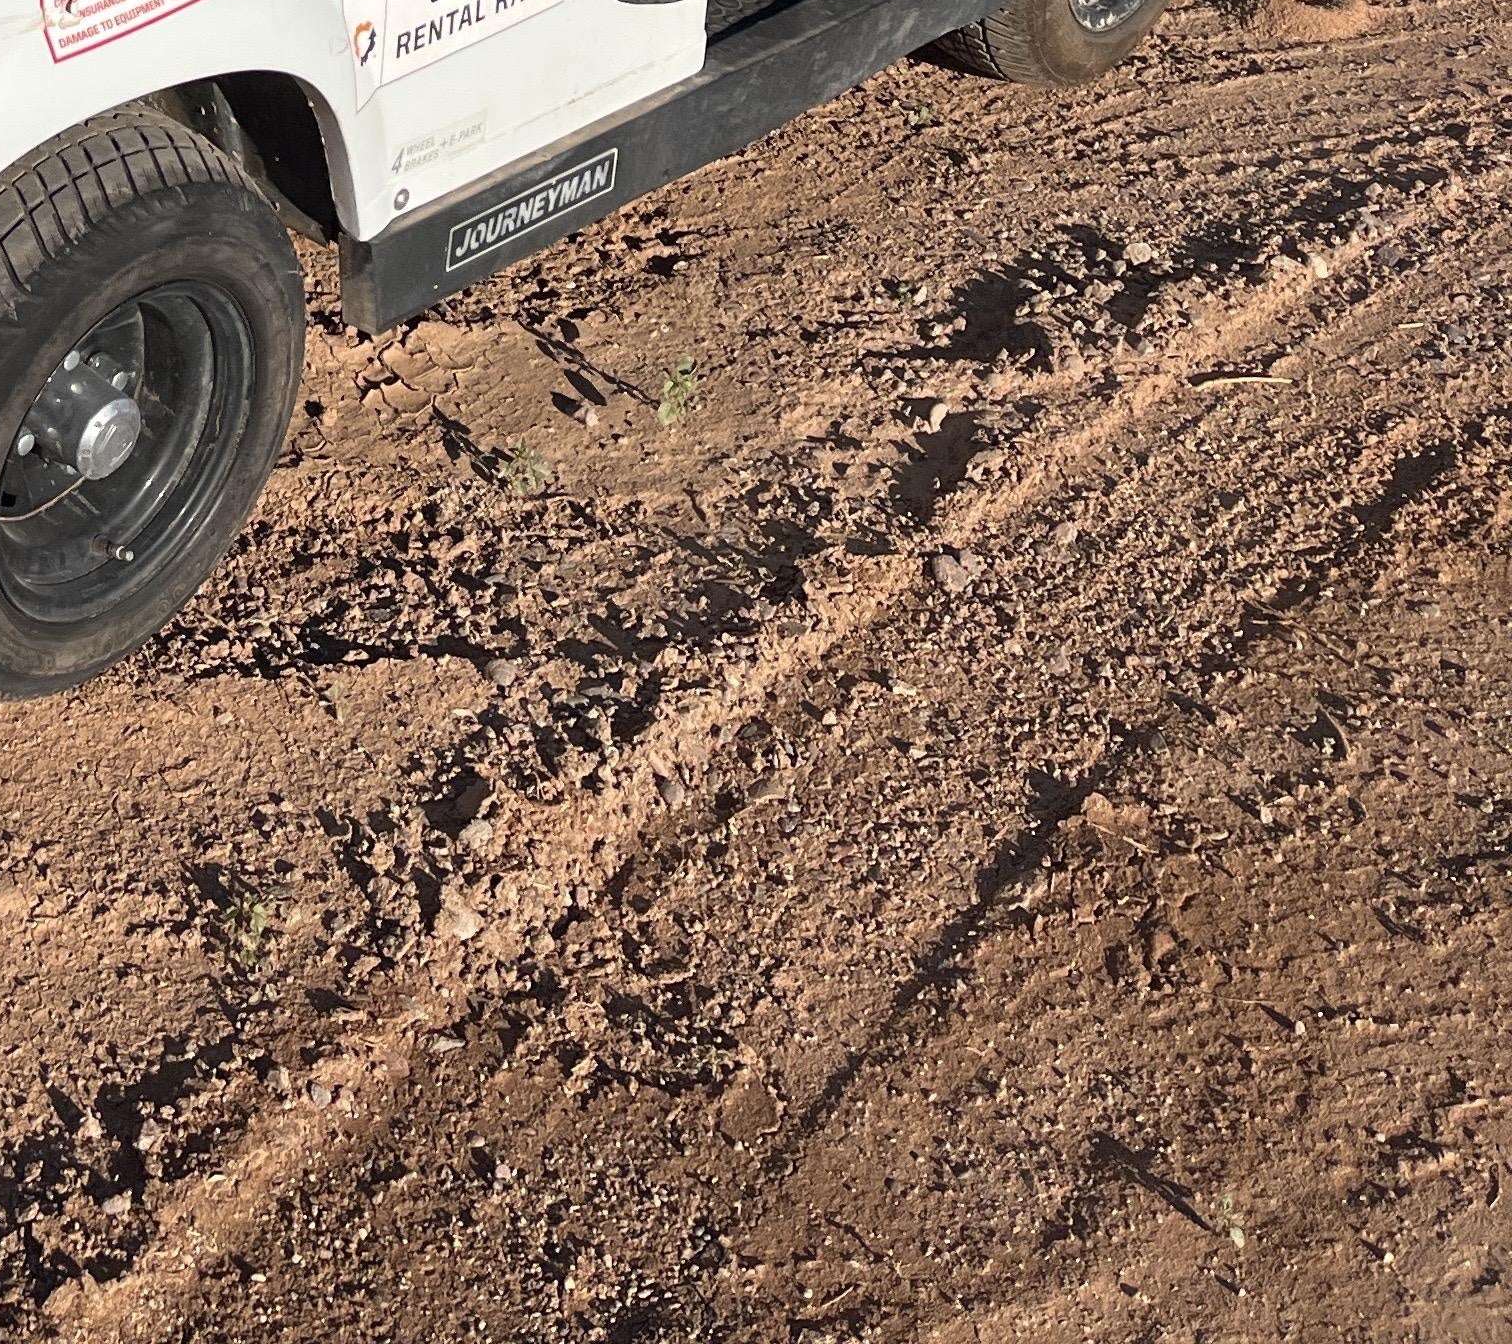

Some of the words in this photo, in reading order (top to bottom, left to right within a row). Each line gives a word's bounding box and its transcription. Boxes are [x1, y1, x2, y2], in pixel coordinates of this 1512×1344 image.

[58, 24, 100, 49] DAMAGE
[100, 19, 114, 31] TO
[395, 0, 487, 59] RENTAL
[391, 146, 405, 175] 4
[455, 160, 611, 258] JOURNEYMAN
